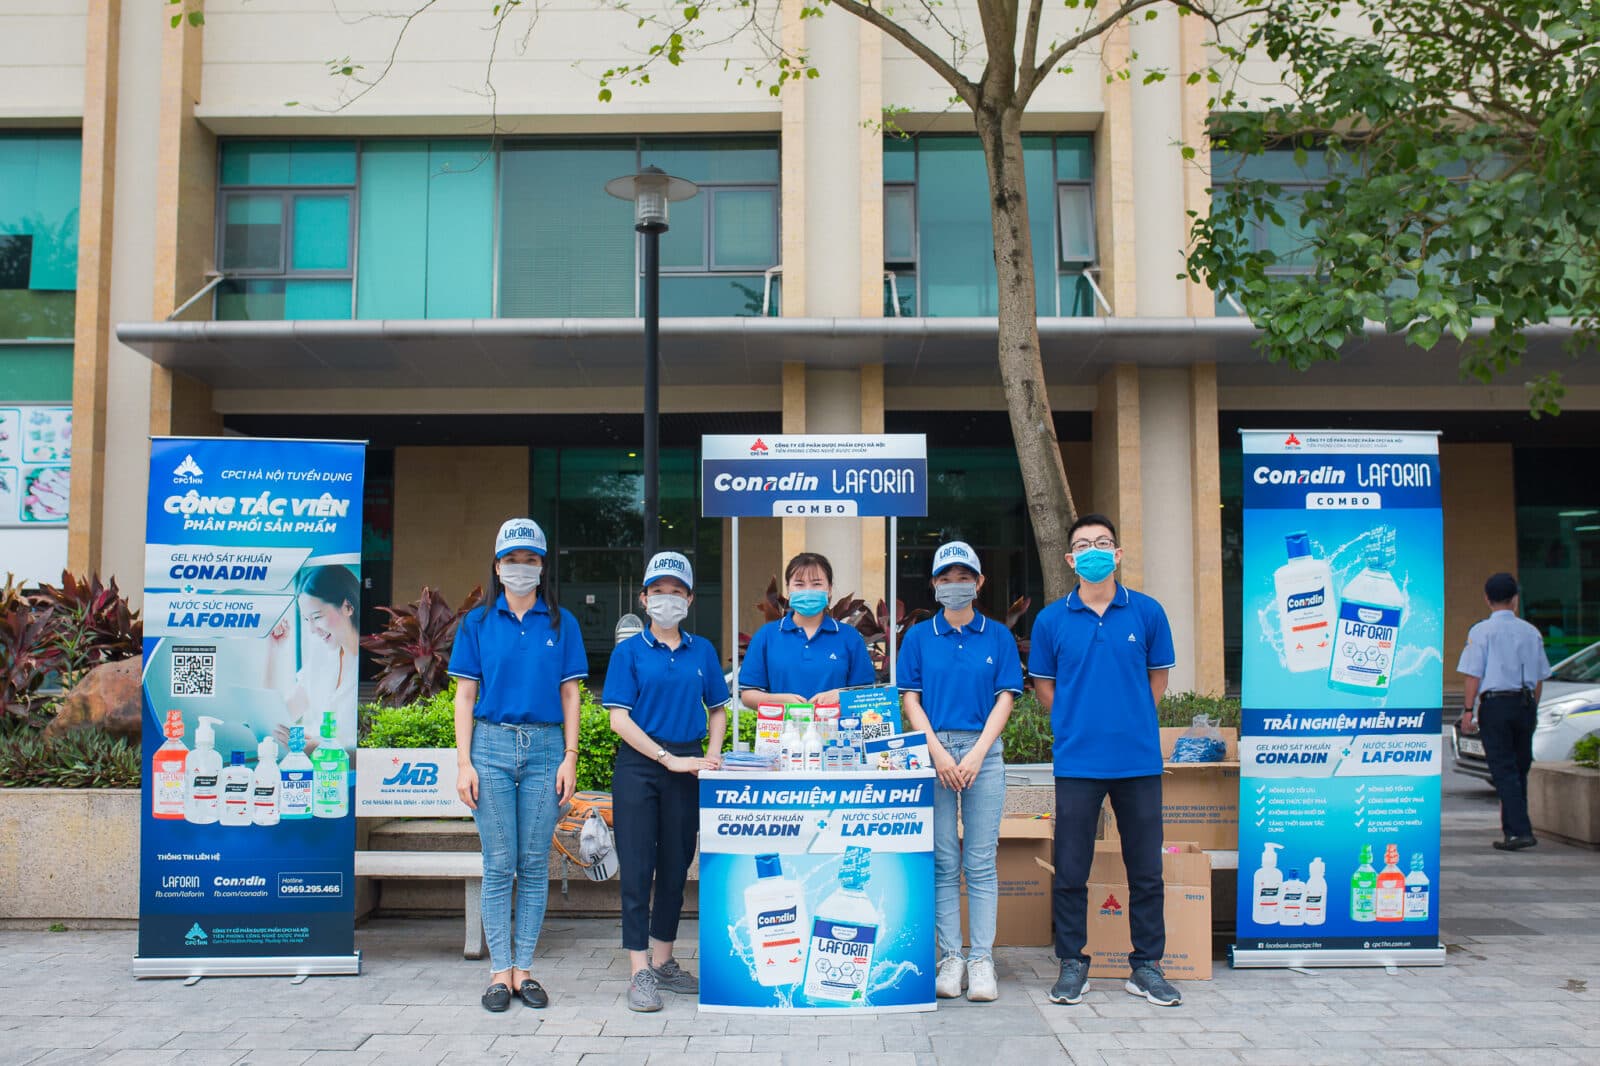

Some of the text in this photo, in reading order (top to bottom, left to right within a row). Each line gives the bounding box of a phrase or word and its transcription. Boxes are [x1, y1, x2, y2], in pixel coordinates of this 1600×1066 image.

[221, 467, 352, 483] CPC1 HÀ NỘI TUYỂN DỤNG
[714, 468, 914, 494] Conadin LAFORIN
[1254, 463, 1431, 487] Conadin LAFORIN
[164, 489, 236, 519] CỘNG
[240, 491, 288, 516] TÁC
[291, 493, 350, 518] VIÊN
[1317, 498, 1370, 506] COMBO
[785, 505, 846, 514] COMBO
[184, 516, 337, 532] PHÂN PHỐI SẢN PHẨM
[504, 526, 534, 540] LAFORIN
[192, 552, 214, 562] KHÔ
[216, 553, 235, 562] SÁT
[236, 552, 272, 563] KHUẨN
[654, 558, 684, 570] LAFORIN
[169, 564, 268, 580] CONADIN
[1288, 594, 1324, 608] Conadin
[167, 612, 261, 628] LAFORIN
[1344, 622, 1392, 641] LAFORIN
[1263, 712, 1426, 732] TRẢI NGHIỆM MIỄN PHÍ
[1256, 752, 1328, 764] CONADIN
[1361, 750, 1432, 764] LAFORIN
[382, 762, 439, 786] MB
[715, 784, 922, 806] TRẢI NGHIỆM MIỄN PHÍ
[717, 823, 800, 836] CONADIN
[840, 821, 923, 836] LAFORIN
[157, 852, 182, 860] THÔNG
[195, 852, 210, 860] LIÊN
[210, 852, 221, 862] HỆ
[162, 876, 200, 888] LAFORIN
[214, 876, 266, 886] Conadin
[281, 885, 340, 894] 0969.295.466
[758, 912, 796, 926] Conadin
[818, 938, 868, 957] LAFORIN
